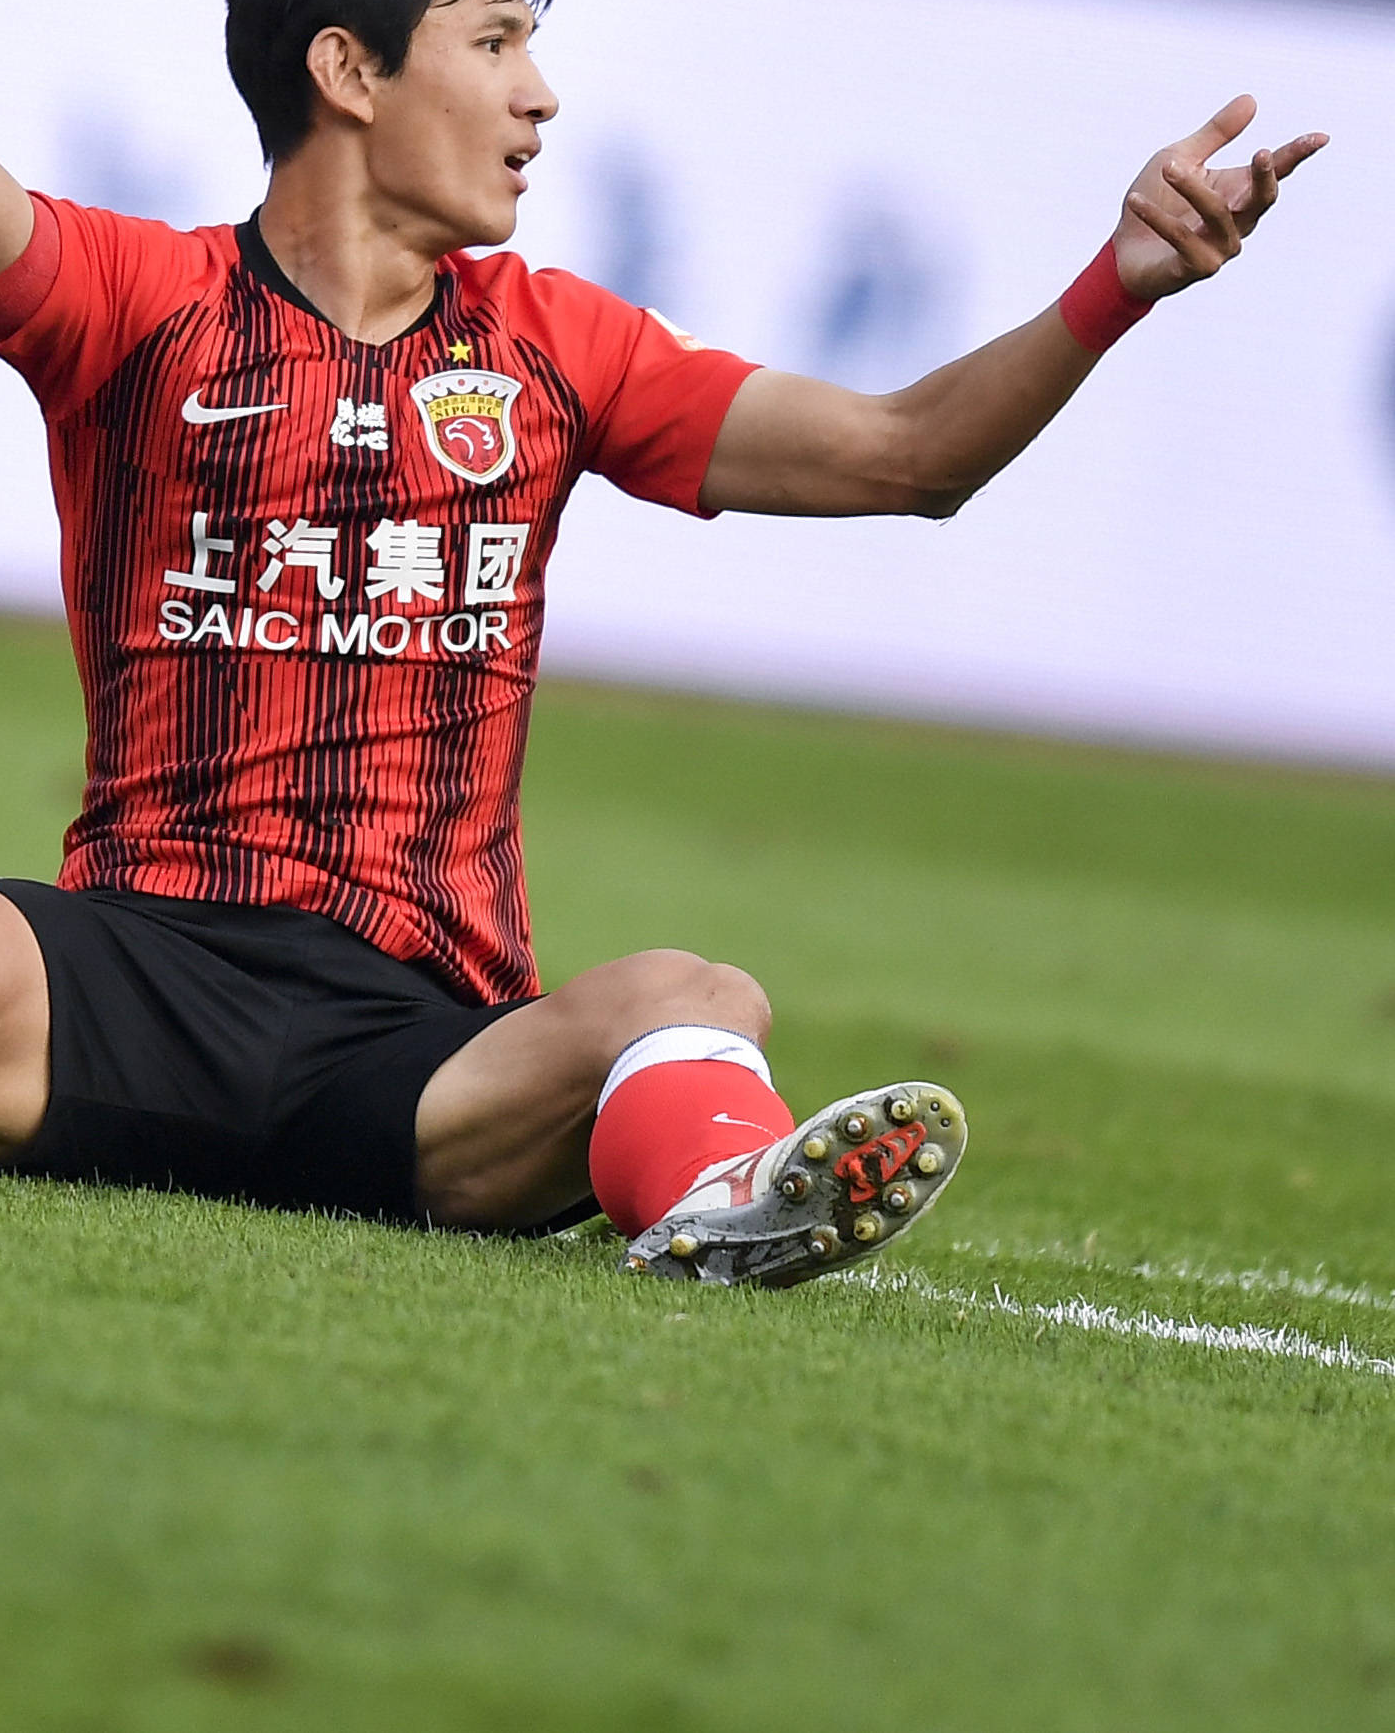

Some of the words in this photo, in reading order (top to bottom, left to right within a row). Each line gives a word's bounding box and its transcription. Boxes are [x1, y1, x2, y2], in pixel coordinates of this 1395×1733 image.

[435, 405, 470, 419] SIPG
[477, 405, 496, 416] FC
[163, 510, 531, 606] 上汽集团
[157, 599, 300, 651] SAIC
[320, 609, 513, 657] MOTOR
